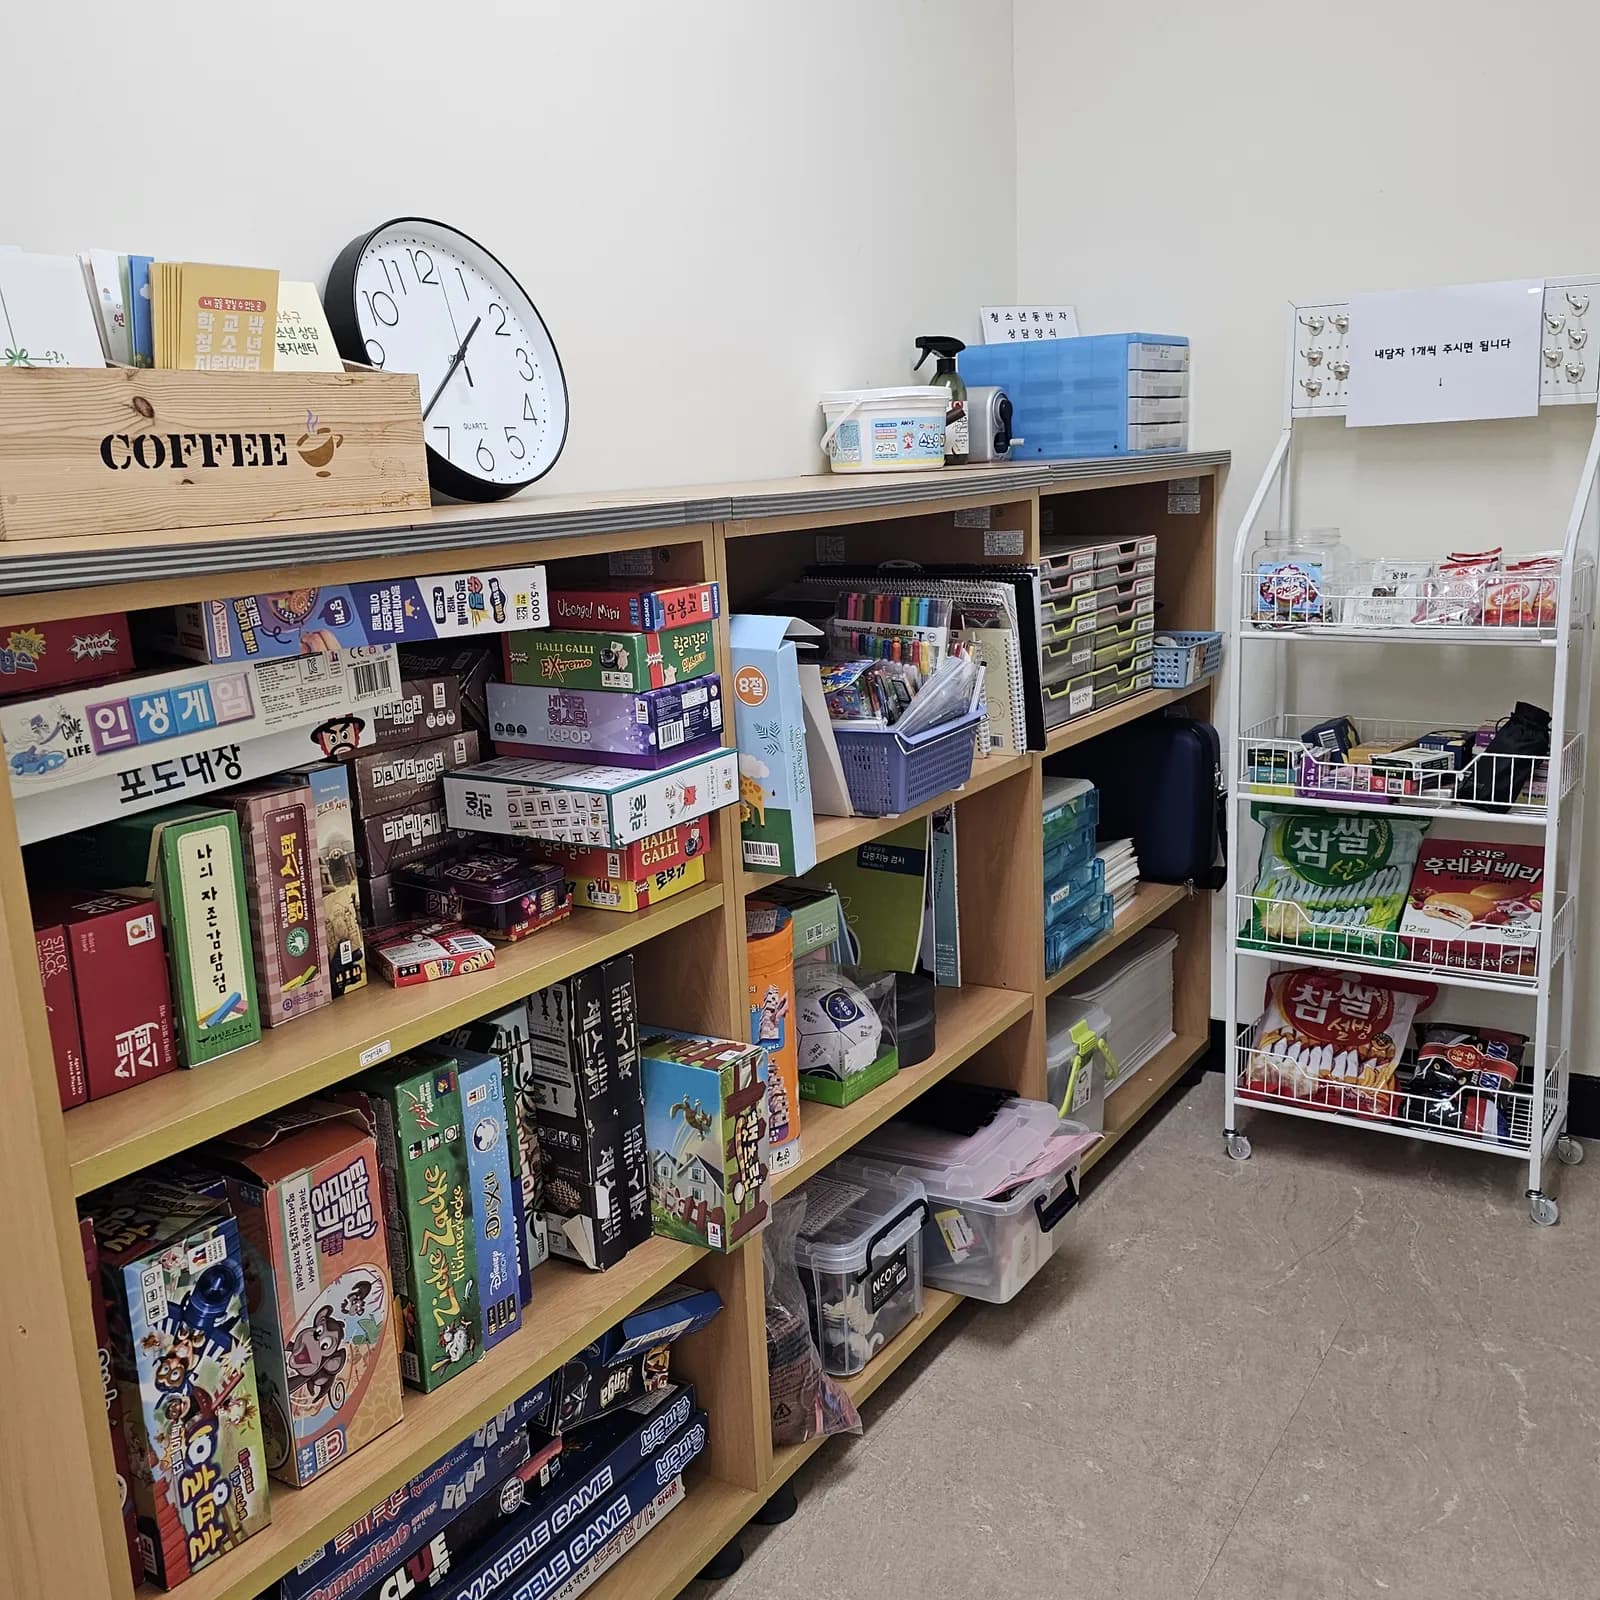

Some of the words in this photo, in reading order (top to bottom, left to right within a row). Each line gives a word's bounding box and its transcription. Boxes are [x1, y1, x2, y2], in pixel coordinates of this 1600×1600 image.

[378, 258, 407, 295] 11
[405, 248, 439, 285] 12
[455, 267, 470, 301] 1
[362, 291, 399, 326] 10
[489, 303, 511, 336] 2
[277, 342, 319, 355] 복지센터
[298, 326, 319, 340] 상담
[1374, 347, 1405, 361] 내담자
[1411, 343, 1437, 357] 1개씩
[1442, 341, 1474, 355] 주시면
[1479, 338, 1512, 353] 됩니다
[364, 339, 385, 369] 9
[516, 348, 534, 381] 3
[523, 393, 538, 425] 4
[433, 426, 450, 459] 7
[463, 422, 489, 431] QUARTZ
[504, 426, 525, 459] 5
[100, 433, 288, 471] COFFEE
[476, 438, 495, 472] 6
[447, 595, 455, 614] 게임
[455, 580, 469, 625] 팽이배틀
[467, 576, 485, 610] 슈팅
[531, 589, 541, 622] 5,000
[557, 600, 593, 619] Ubongo!
[598, 605, 621, 620] Mini
[667, 599, 697, 620] 우봉고
[245, 596, 262, 627] 당기면
[642, 599, 650, 627] KOSMOS
[79, 639, 110, 651] AMIGO
[535, 642, 563, 652] HALLI
[565, 644, 594, 654] GALLI
[672, 632, 709, 656] 할리갈리
[738, 676, 763, 697] 8절
[61, 719, 83, 738] GAME
[95, 677, 245, 746] 인생게임
[67, 744, 91, 758] LIFE
[546, 728, 592, 744] K-POP
[117, 744, 242, 804] 포도대장
[640, 826, 678, 850] HALLI
[641, 843, 679, 866] GALLI
[1291, 817, 1377, 869] 참쌀
[1462, 848, 1505, 860] 오리온
[197, 844, 214, 878] 나의
[1422, 857, 1543, 884] 후레쉬베리
[200, 887, 223, 950] 자존감
[41, 937, 58, 979] STACK
[53, 936, 68, 971] STICK
[210, 952, 227, 993] 탐험
[620, 981, 632, 1014] 체커
[1291, 975, 1378, 1024] 참쌀
[134, 1022, 159, 1067] 스택
[1328, 1018, 1372, 1040] 설병
[114, 1031, 136, 1078] 스틱
[616, 1023, 637, 1081] 체스
[631, 1122, 643, 1156] 체커
[309, 1176, 343, 1240] 몽키
[338, 1157, 378, 1238] 텀블링
[627, 1164, 647, 1221] 체스
[418, 1164, 457, 1257] Zacke
[452, 1185, 465, 1283] Hühnerkacke
[427, 1248, 461, 1328] Zicke
[410, 1463, 450, 1497] Rummikub
[450, 1451, 468, 1465] Classic
[181, 1422, 231, 1562] 루핑루이
[457, 1520, 551, 1600] MARBLE
[552, 1465, 613, 1533] GAME
[570, 1495, 632, 1563] GAME
[380, 1532, 449, 1600] CLUE
